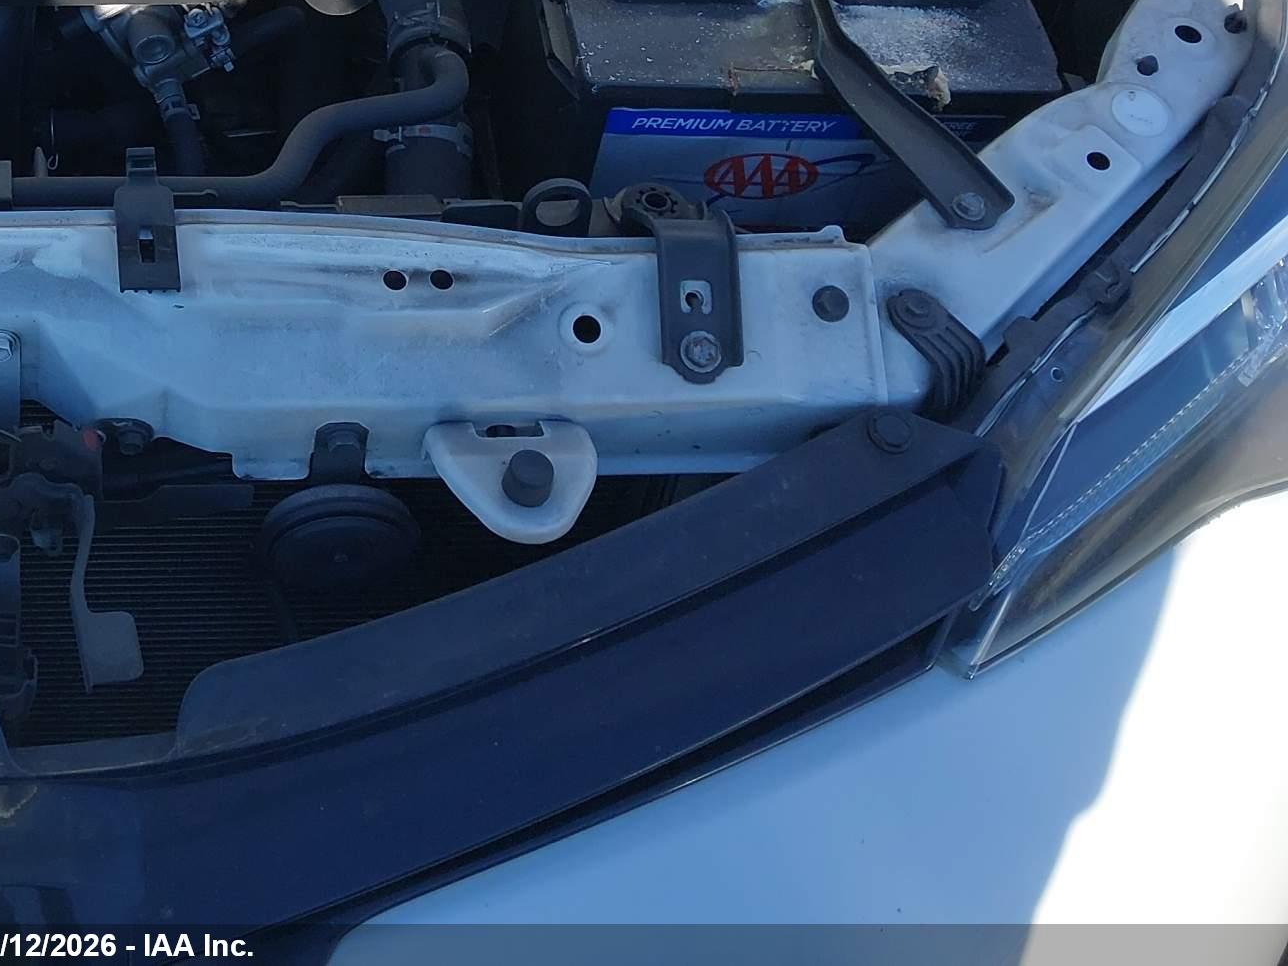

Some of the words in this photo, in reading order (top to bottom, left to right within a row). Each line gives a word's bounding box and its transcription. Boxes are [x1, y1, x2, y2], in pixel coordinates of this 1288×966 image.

[631, 117, 733, 131] PREMIUM
[735, 118, 837, 133] BATTERY
[712, 153, 812, 198] AAA
